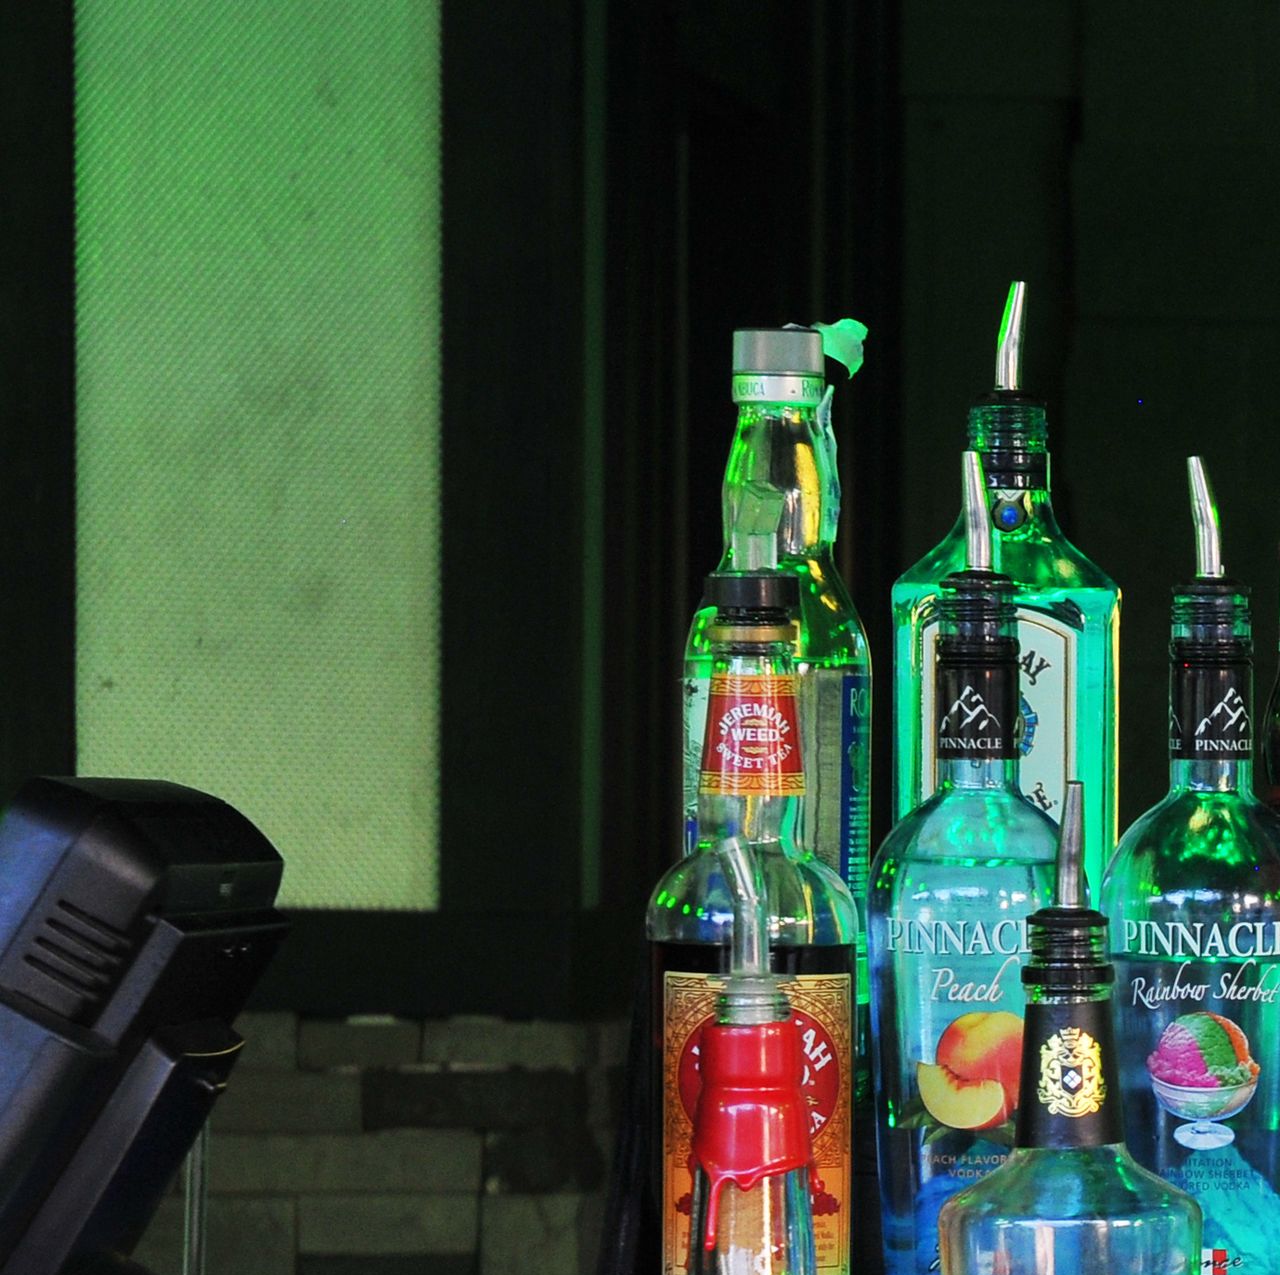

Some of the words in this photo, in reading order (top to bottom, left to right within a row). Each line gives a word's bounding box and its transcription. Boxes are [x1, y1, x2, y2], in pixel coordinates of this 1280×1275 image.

[718, 702, 790, 735] JEREMIAH
[731, 728, 780, 742] WEED
[940, 737, 1002, 750] PINNACLE
[716, 742, 764, 768] SWEET
[768, 744, 793, 765] TEA
[930, 957, 1020, 1004] Peach
[1131, 960, 1207, 1009] Rainbow
[1217, 962, 1280, 1004] Sherbet
